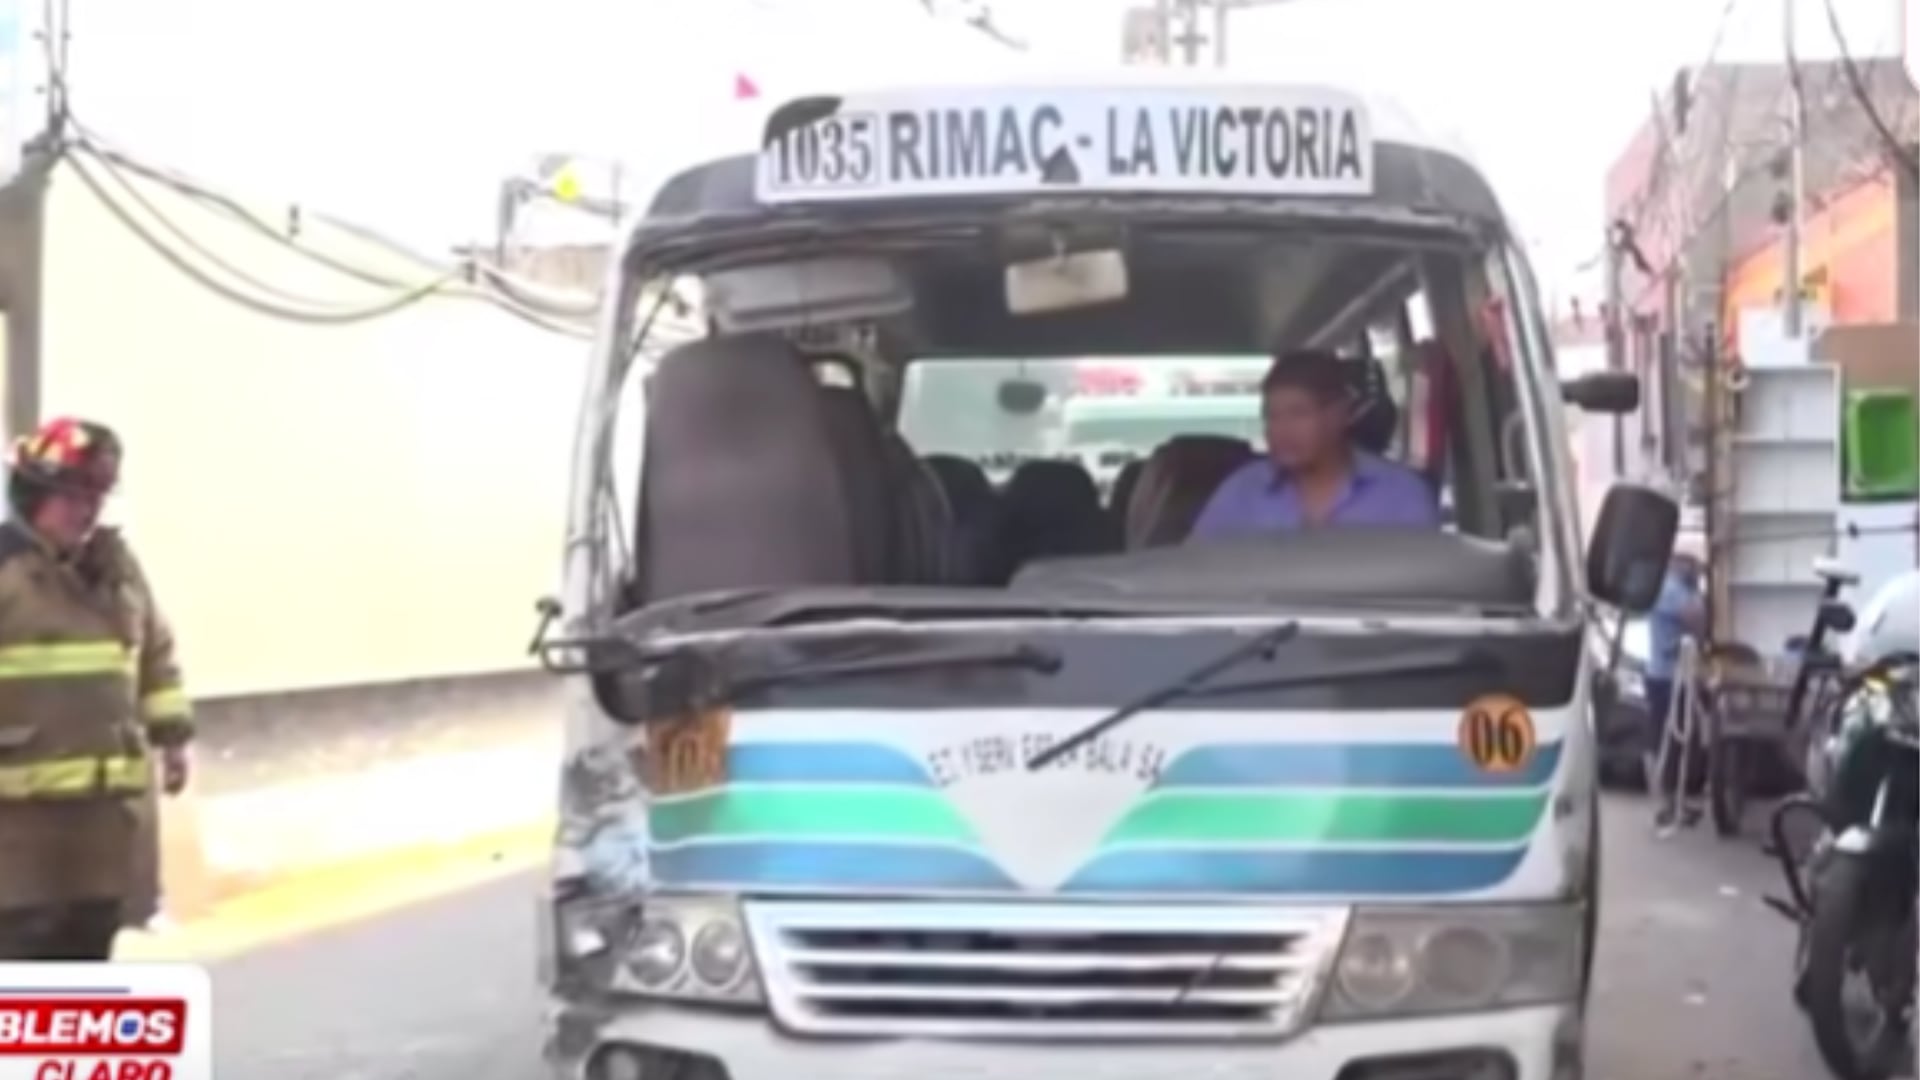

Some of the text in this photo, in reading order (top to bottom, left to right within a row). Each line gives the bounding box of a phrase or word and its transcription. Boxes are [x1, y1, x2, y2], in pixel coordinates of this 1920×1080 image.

[778, 120, 872, 184] 1035
[889, 104, 1063, 181] RIMAC
[1107, 106, 1158, 175] LA
[1170, 106, 1362, 179] VICTORIA
[1470, 709, 1523, 767] 06
